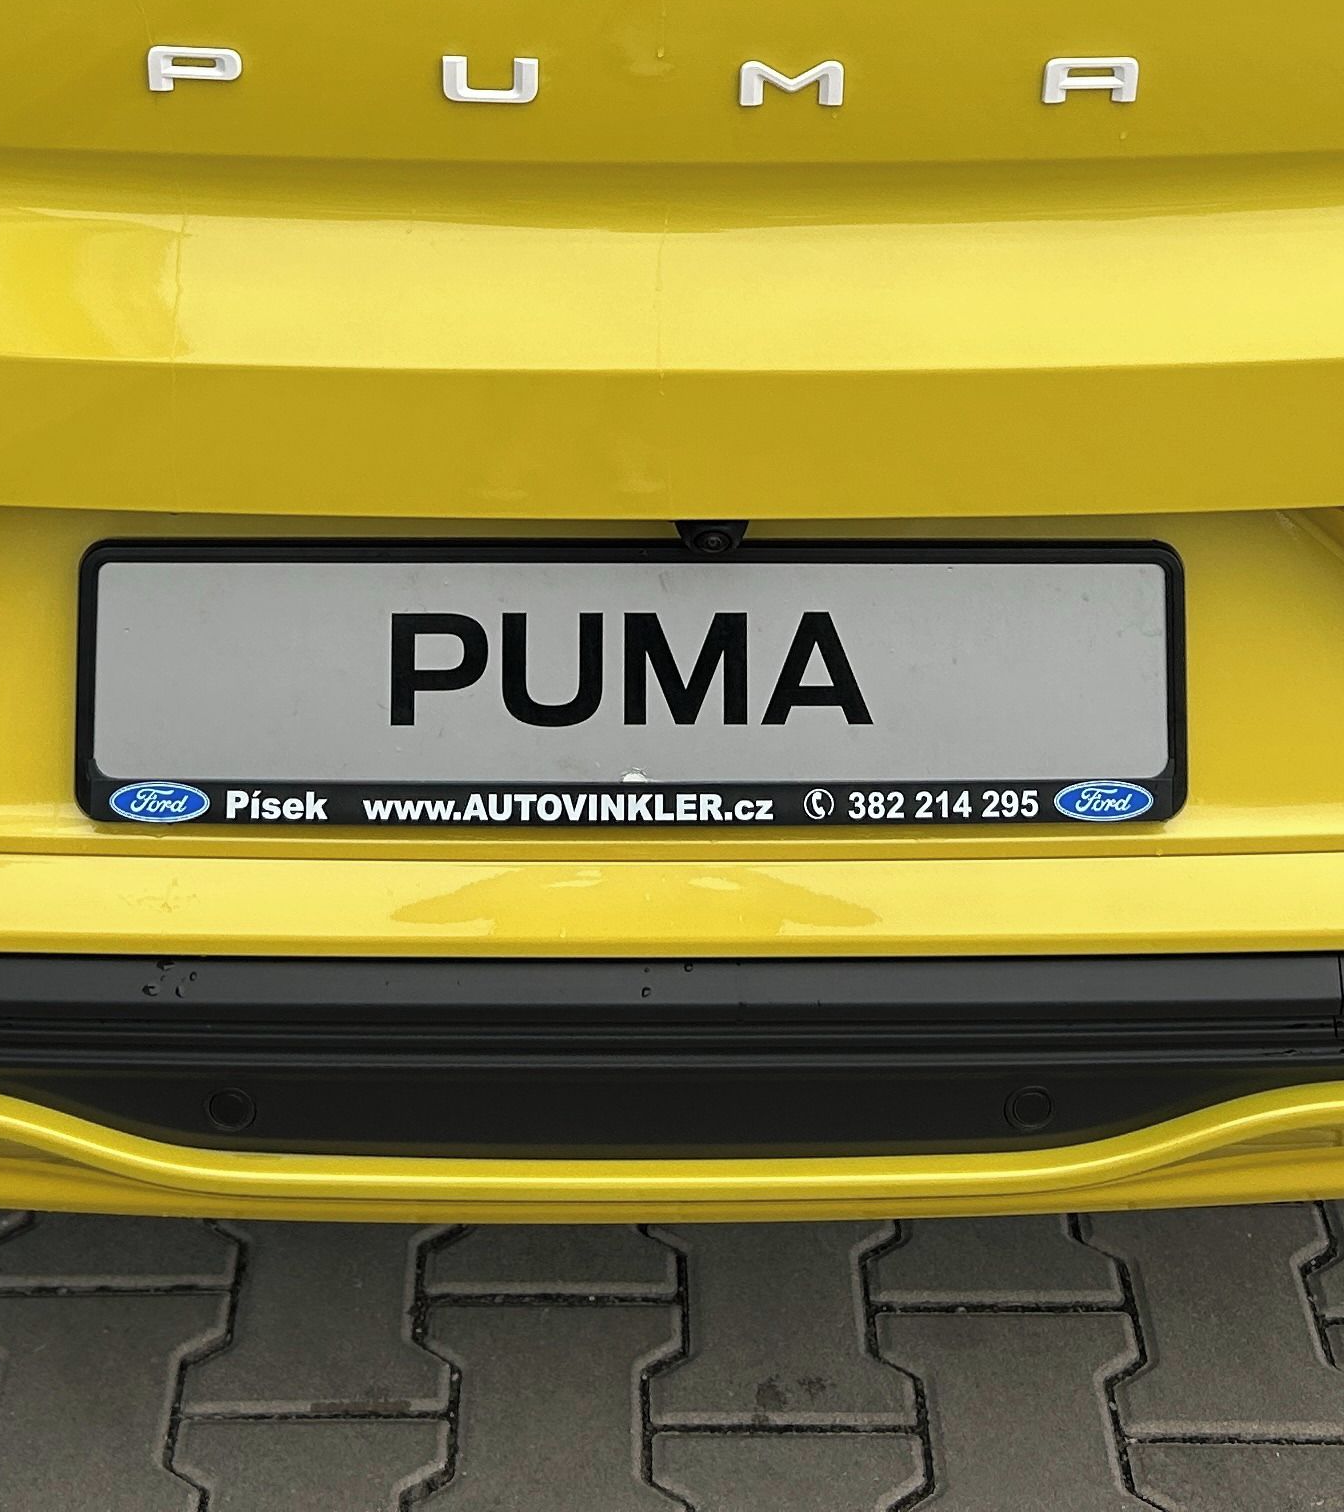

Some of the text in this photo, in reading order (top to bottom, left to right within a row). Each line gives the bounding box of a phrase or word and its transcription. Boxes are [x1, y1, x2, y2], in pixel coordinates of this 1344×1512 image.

[390, 611, 874, 728] PUMA
[130, 788, 1132, 822] Ford Písek www.AUTOVINKLER.cz 382 214 295 Ford
